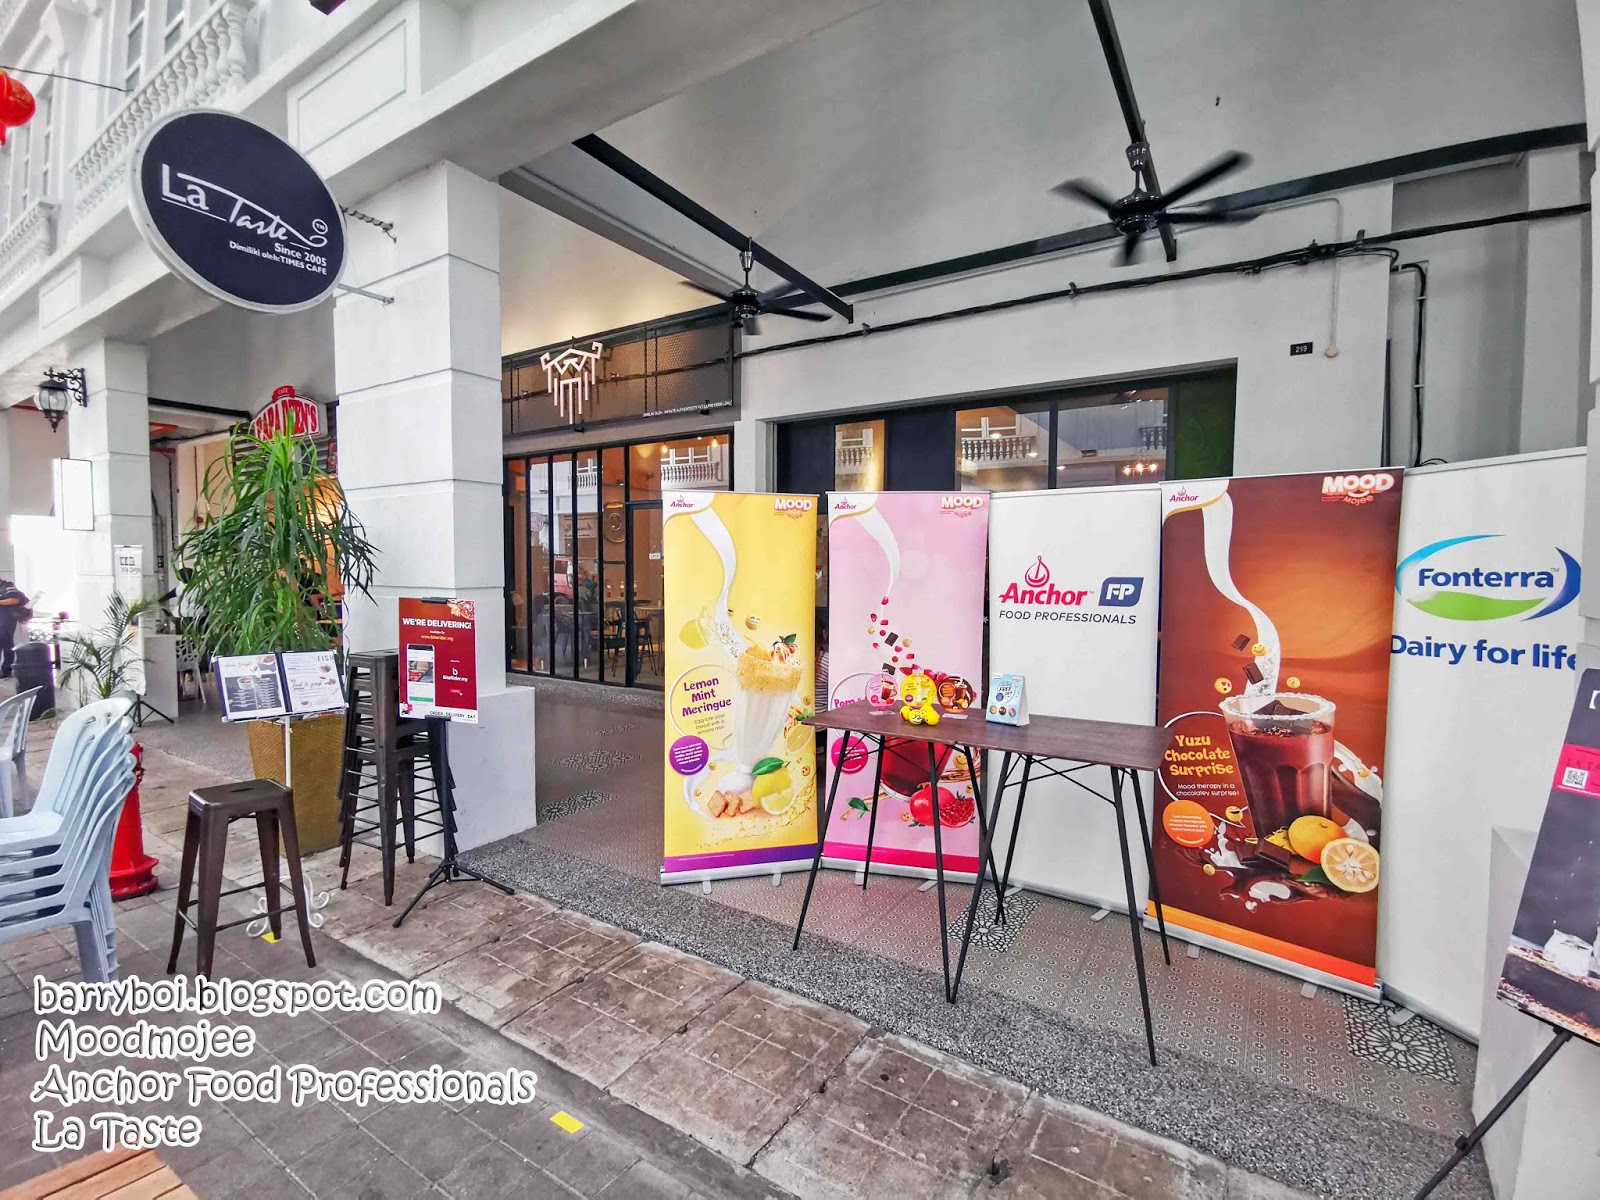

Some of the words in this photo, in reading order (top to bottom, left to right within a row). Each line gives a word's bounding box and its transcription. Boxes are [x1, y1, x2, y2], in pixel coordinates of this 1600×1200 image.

[162, 163, 209, 211] La
[229, 241, 260, 256] Dimiliki
[306, 263, 327, 275] CAFE
[274, 243, 302, 259] Since
[304, 251, 327, 266] 2005
[1295, 345, 1308, 353] 219
[1322, 473, 1395, 494] MOOD
[774, 498, 812, 511] MOOD
[940, 496, 984, 509] MOOD
[1169, 494, 1199, 502] Anchor
[1343, 495, 1374, 506] Mojee
[1418, 568, 1554, 588] Fonterra
[998, 583, 1088, 606] Anchor
[1106, 584, 1135, 600] FP
[402, 618, 426, 626] WE'RE
[427, 619, 472, 630] DELIVERING!
[999, 610, 1031, 620] FOOD
[1034, 611, 1137, 625] PROFESSIONALS
[1390, 635, 1467, 665] Dairy
[1473, 640, 1526, 665] for
[684, 677, 720, 692] Lemon
[692, 688, 716, 702] Mint
[682, 698, 732, 717] Meringue
[1175, 734, 1212, 748] Yuzu
[1164, 748, 1231, 762] Chocolate
[1170, 762, 1234, 778] Surprise
